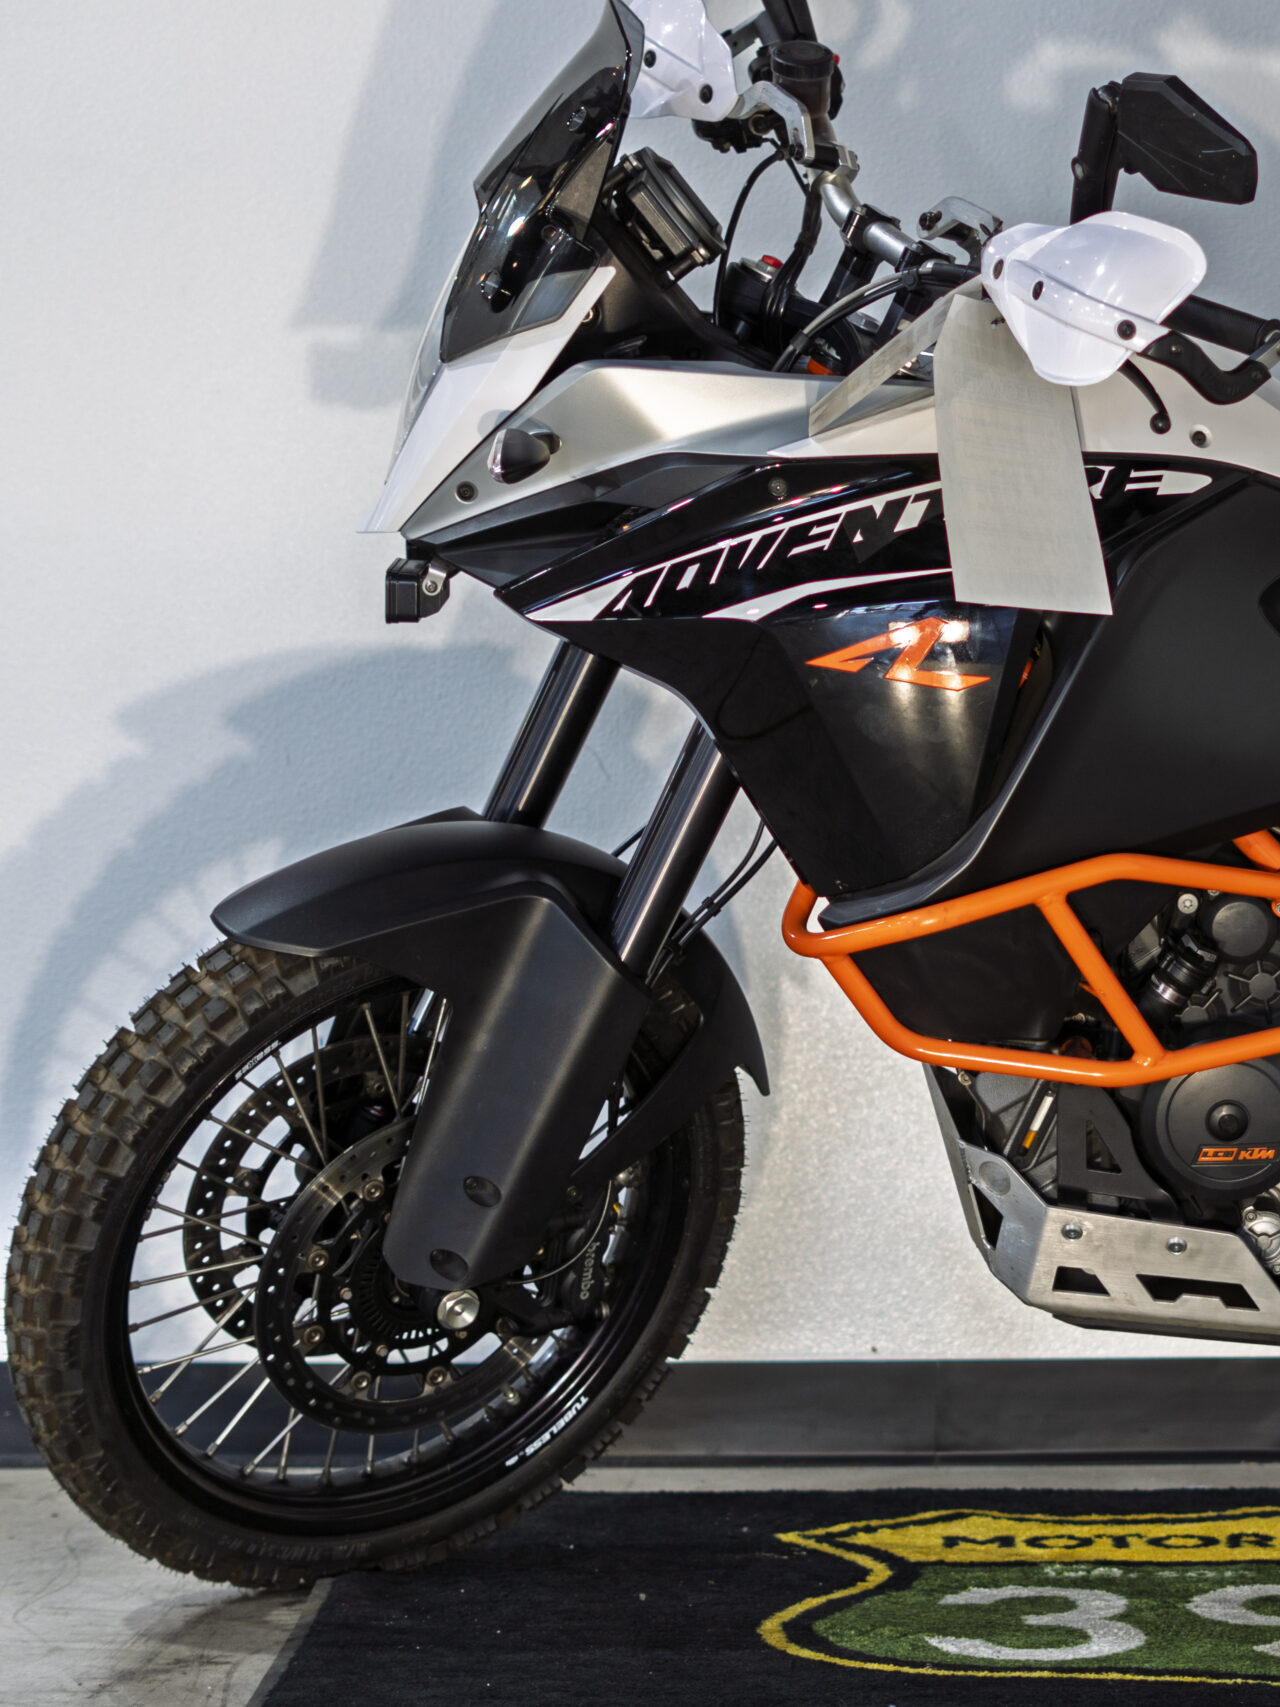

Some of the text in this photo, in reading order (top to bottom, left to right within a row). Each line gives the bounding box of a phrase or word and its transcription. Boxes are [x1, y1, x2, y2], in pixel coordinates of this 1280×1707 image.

[1238, 1147, 1275, 1160] KTM
[580, 1242, 600, 1300] brembo
[525, 1396, 589, 1456] TUBELESS
